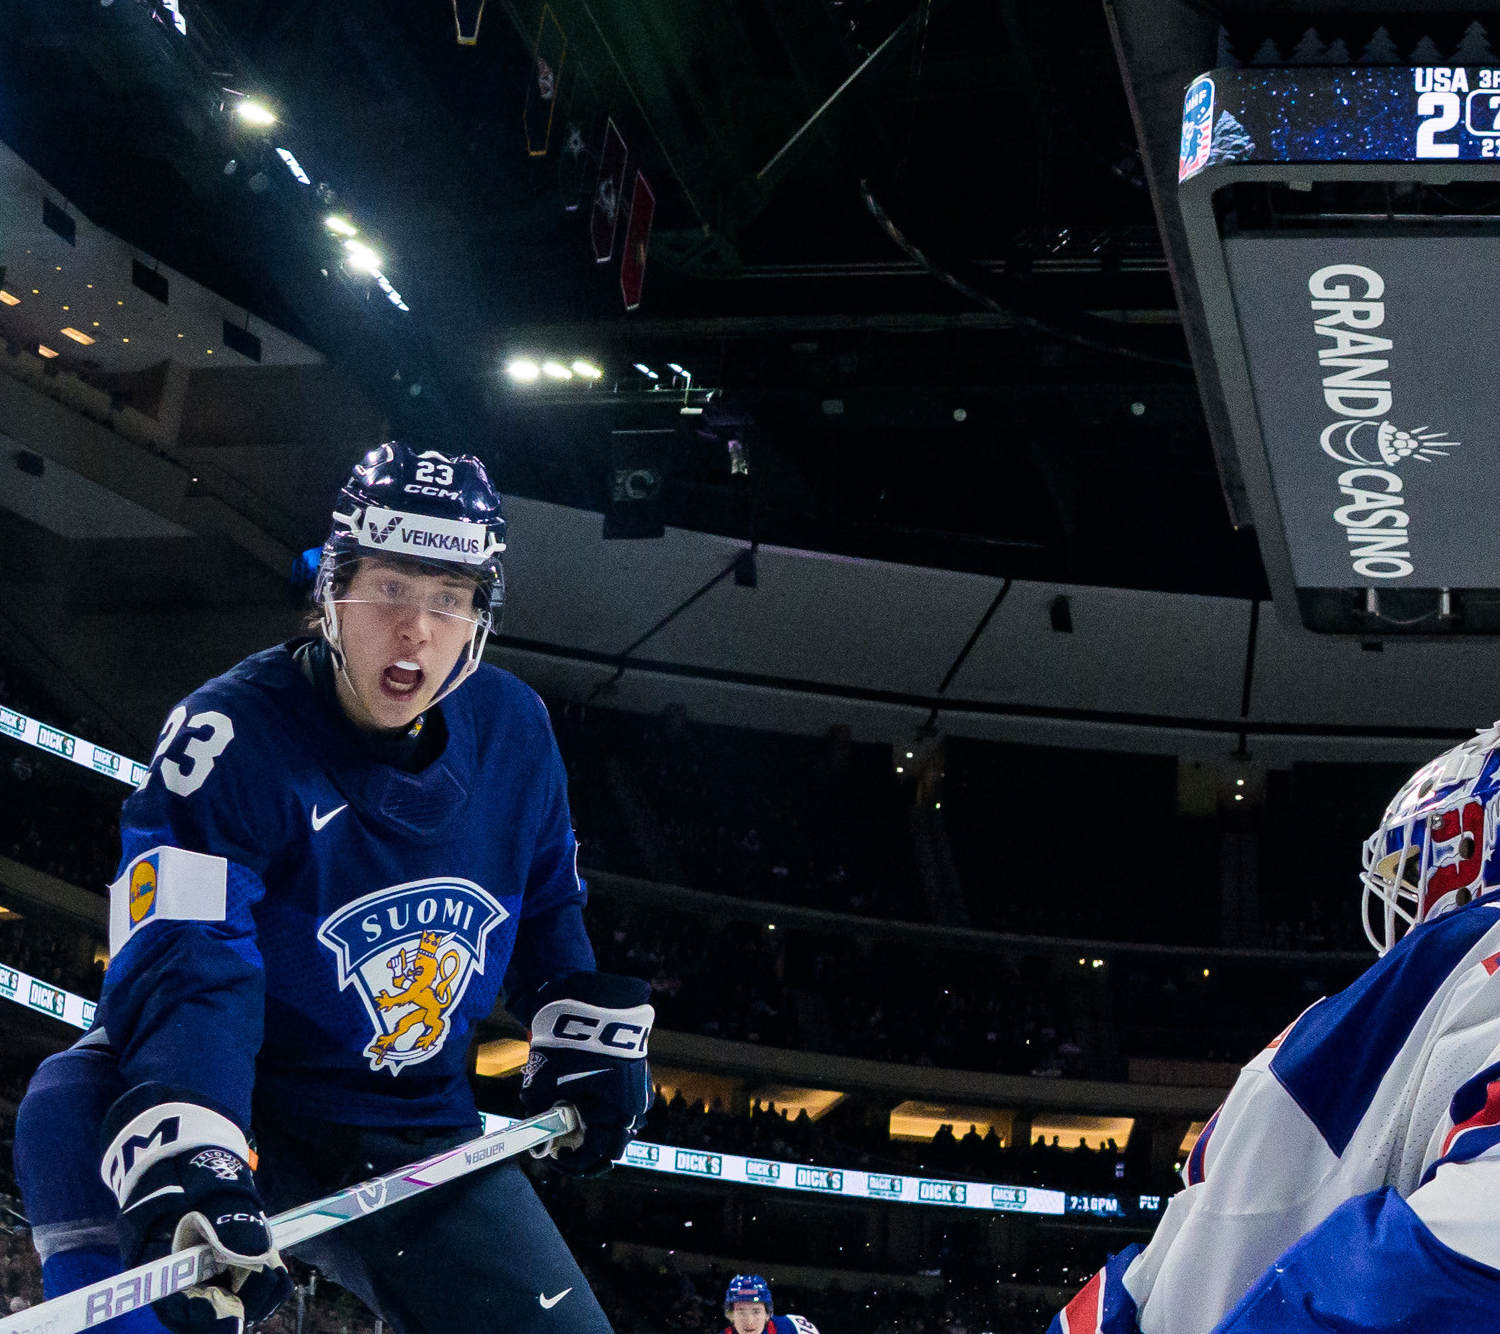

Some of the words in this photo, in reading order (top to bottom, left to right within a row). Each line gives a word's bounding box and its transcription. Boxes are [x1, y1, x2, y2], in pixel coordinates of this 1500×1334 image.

[1415, 68, 1469, 93] USA
[1416, 95, 1460, 159] 2
[1309, 264, 1392, 418] GRAND
[416, 460, 454, 486] 23
[403, 483, 459, 501] CCM
[1333, 470, 1414, 579] CASINO
[402, 528, 480, 555] VEIKKAUS
[39, 728, 75, 756] DICK'S
[362, 895, 475, 940] SUOMI
[31, 982, 65, 1014] DICK'S
[552, 1012, 649, 1052] CC
[677, 1153, 721, 1174] DICK'S
[921, 1182, 966, 1203] DICK'S
